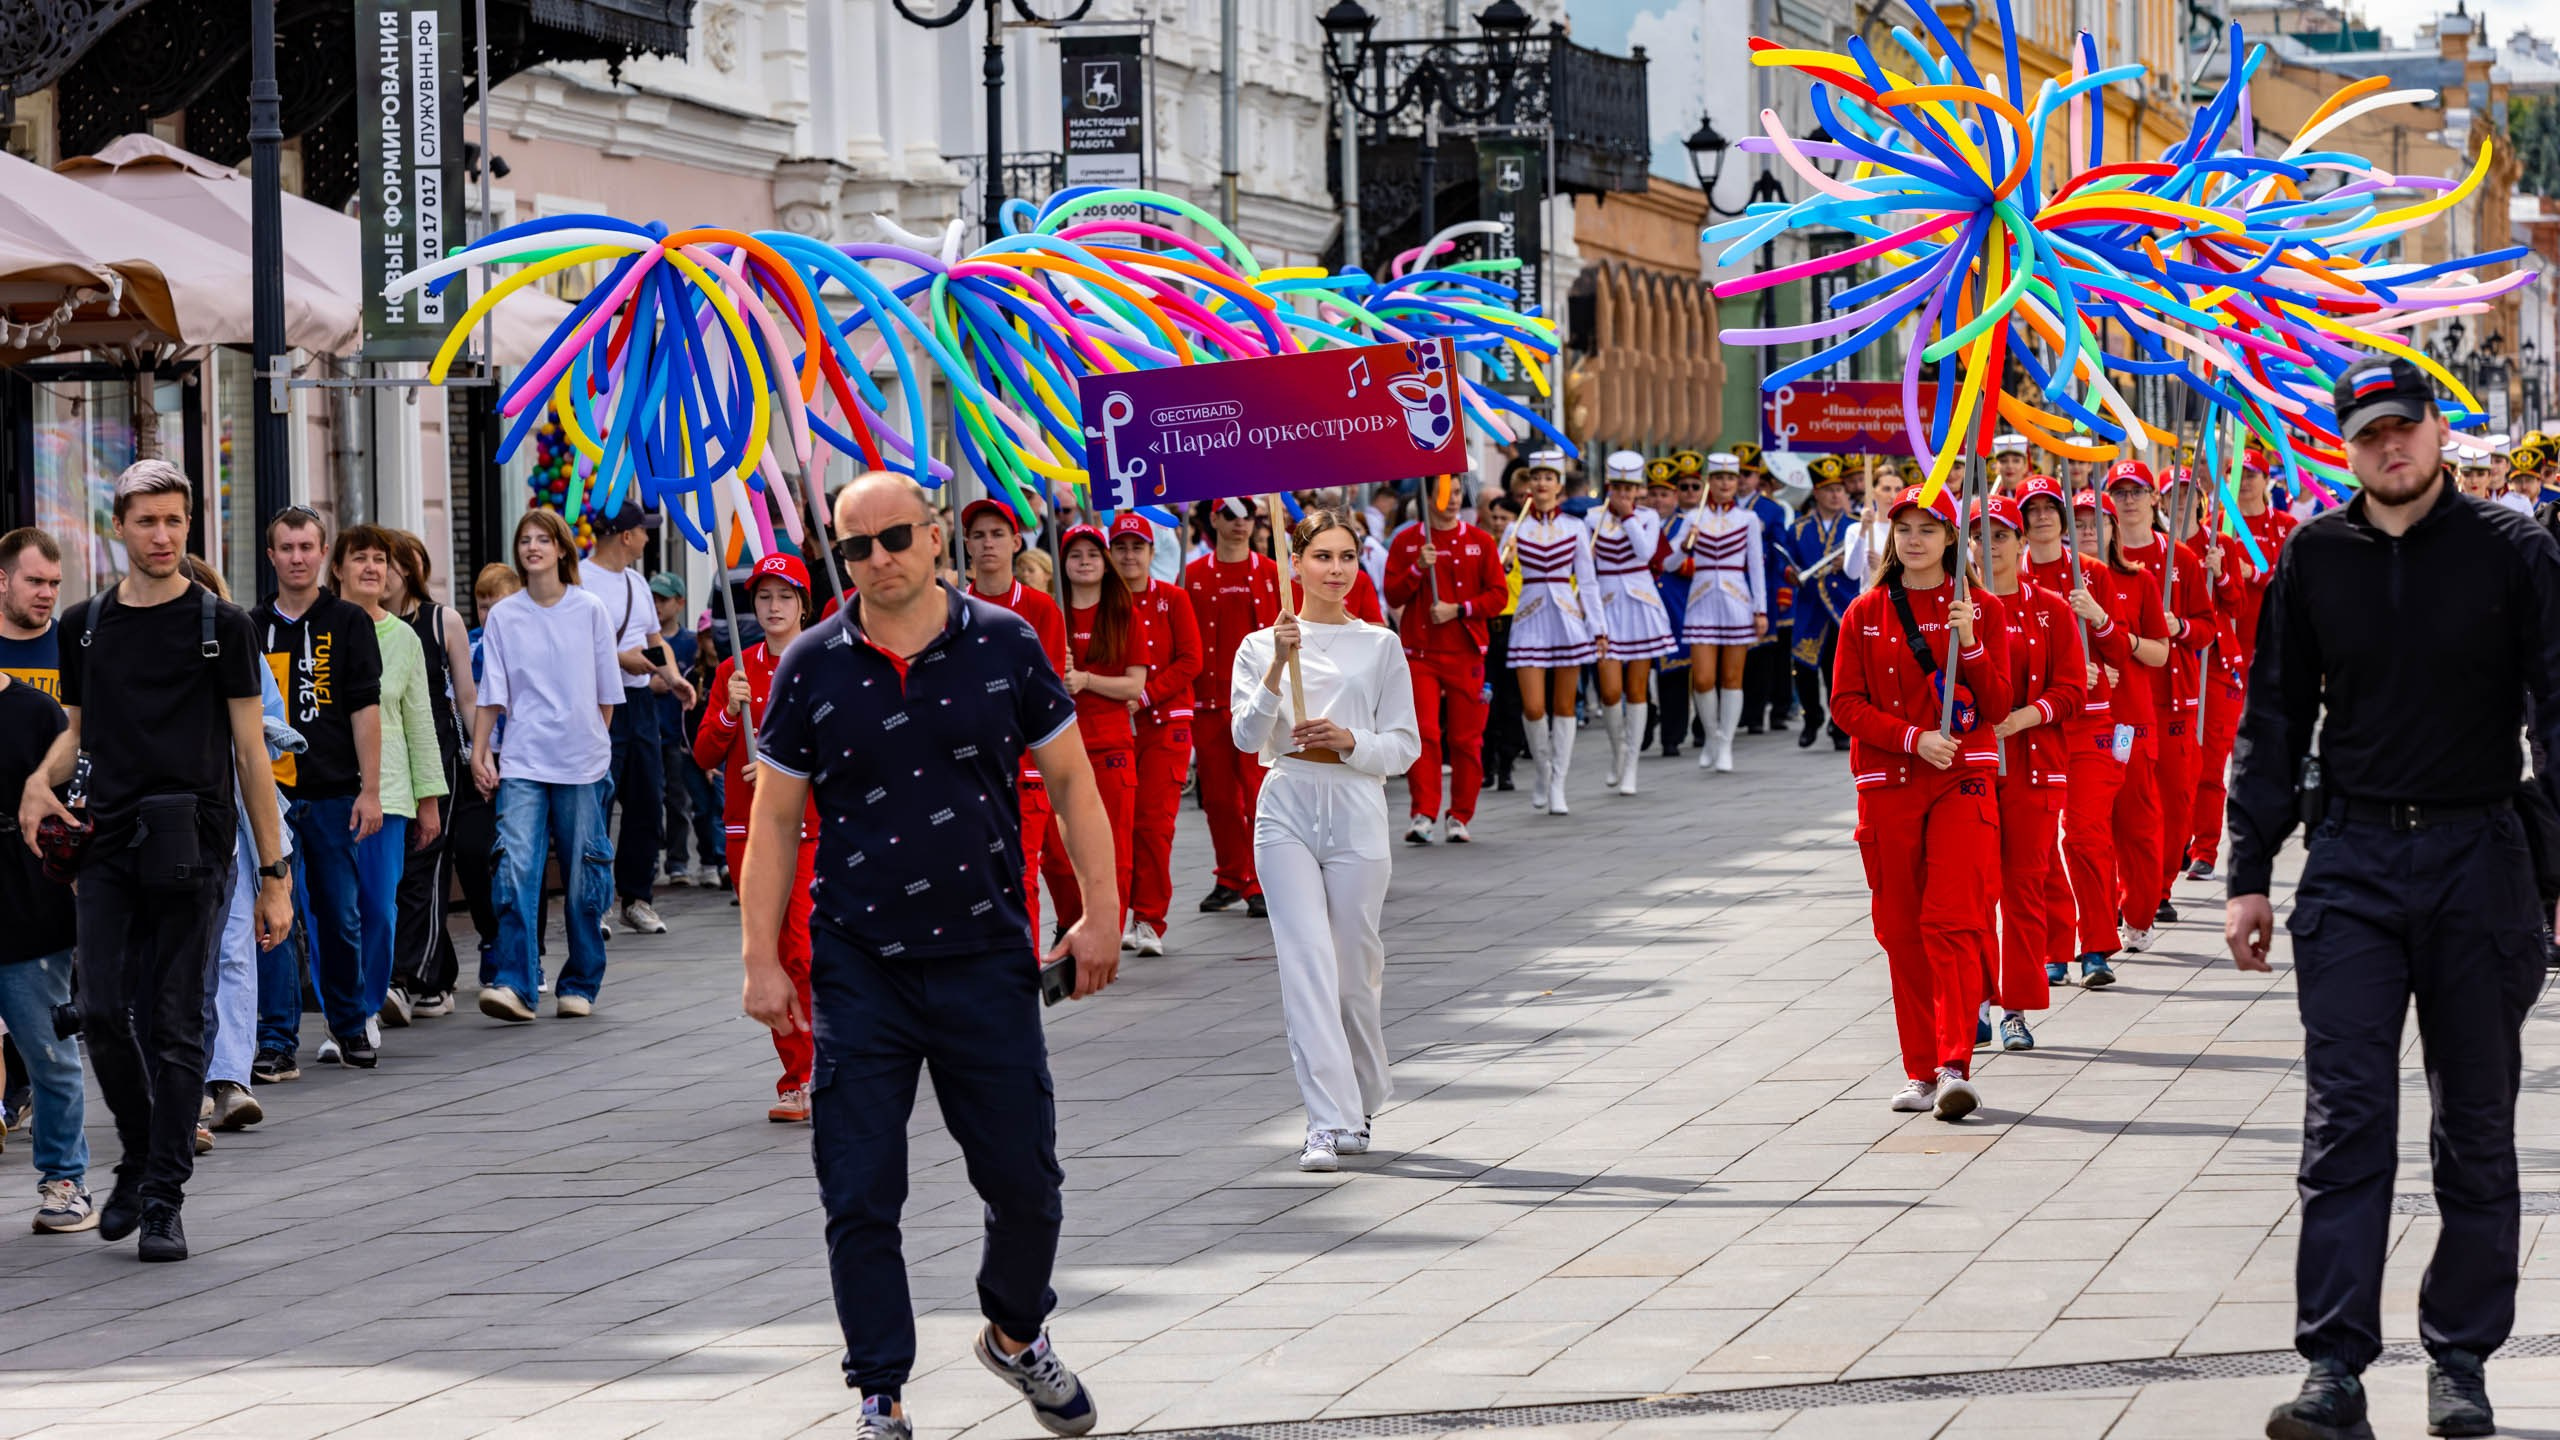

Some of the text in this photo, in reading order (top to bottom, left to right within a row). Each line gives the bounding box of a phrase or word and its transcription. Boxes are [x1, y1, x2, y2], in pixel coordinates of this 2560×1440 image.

[417, 20, 435, 158] СЛУЖУВНН.РФ
[380, 11, 403, 227] ФОРМИРОВАНИЯ
[1070, 116, 1140, 128] НАСТОЯЩАЯ
[1070, 128, 1127, 138] МУЖСКАЯ
[1070, 139, 1115, 149] РАБОТА
[422, 175, 436, 207] 017
[1110, 204, 1137, 216] 000
[422, 212, 437, 233] 17
[1157, 404, 1237, 423] ФЕСТИВАЛЬ
[1148, 414, 1398, 456] «Парад оркестров»
[1809, 418, 1880, 433] губернский
